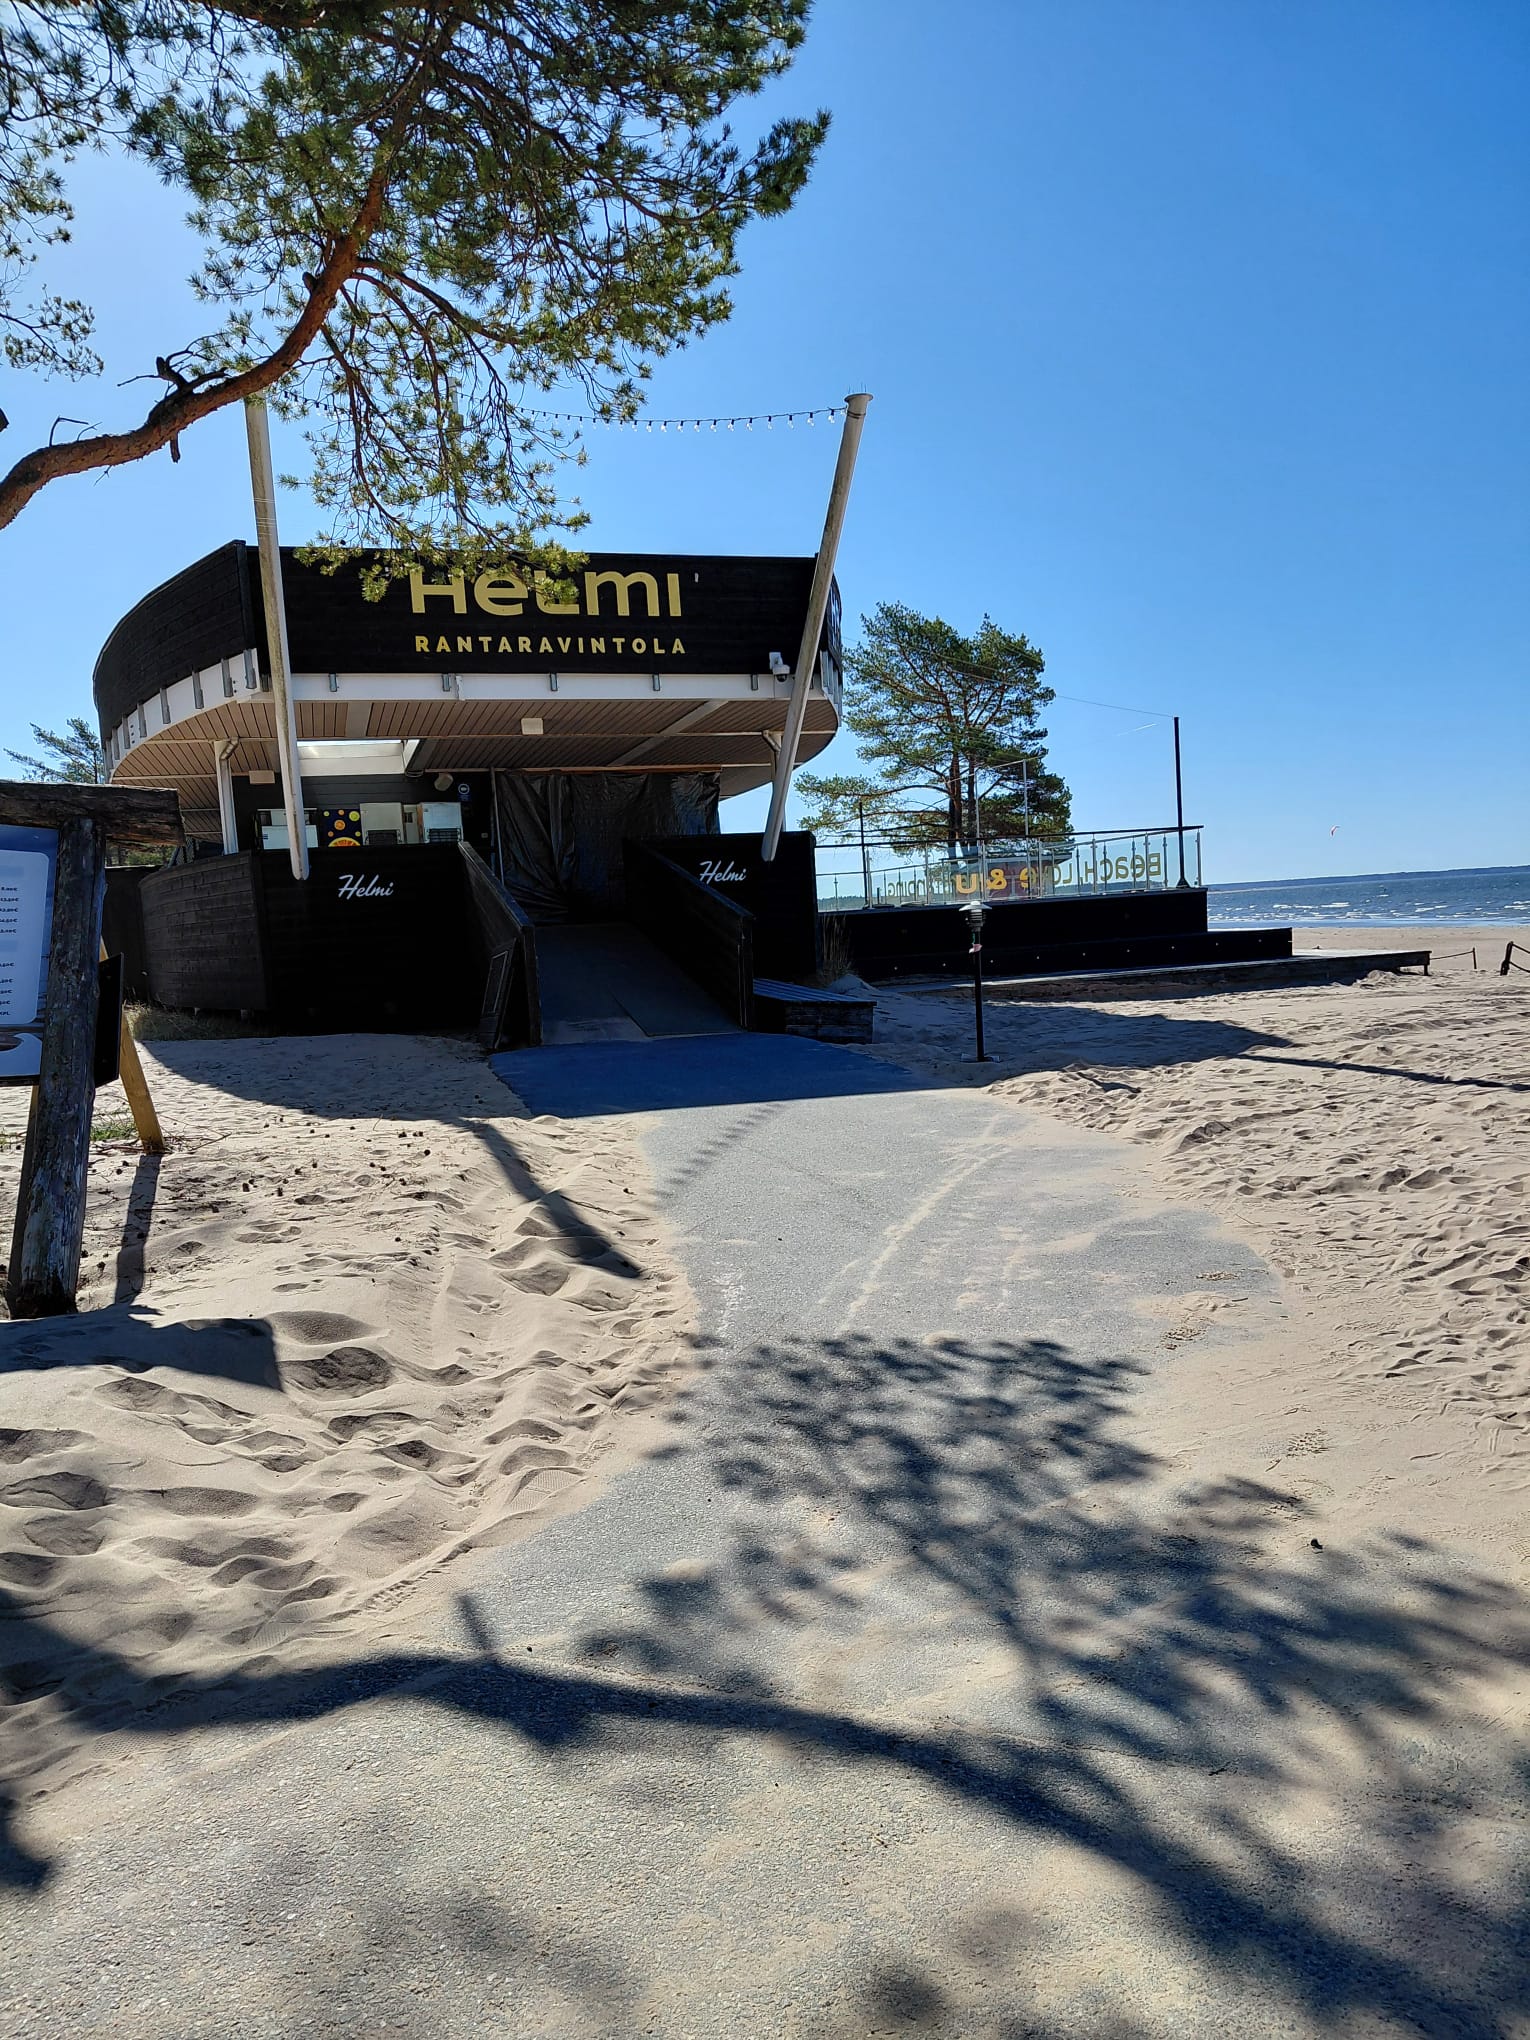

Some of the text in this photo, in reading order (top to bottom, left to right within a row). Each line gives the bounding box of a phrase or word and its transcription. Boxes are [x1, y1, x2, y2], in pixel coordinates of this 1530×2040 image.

[415, 635, 686, 655] RANTARAVINTOLA
[699, 860, 747, 885] Helmi
[338, 874, 394, 900] Helmi
